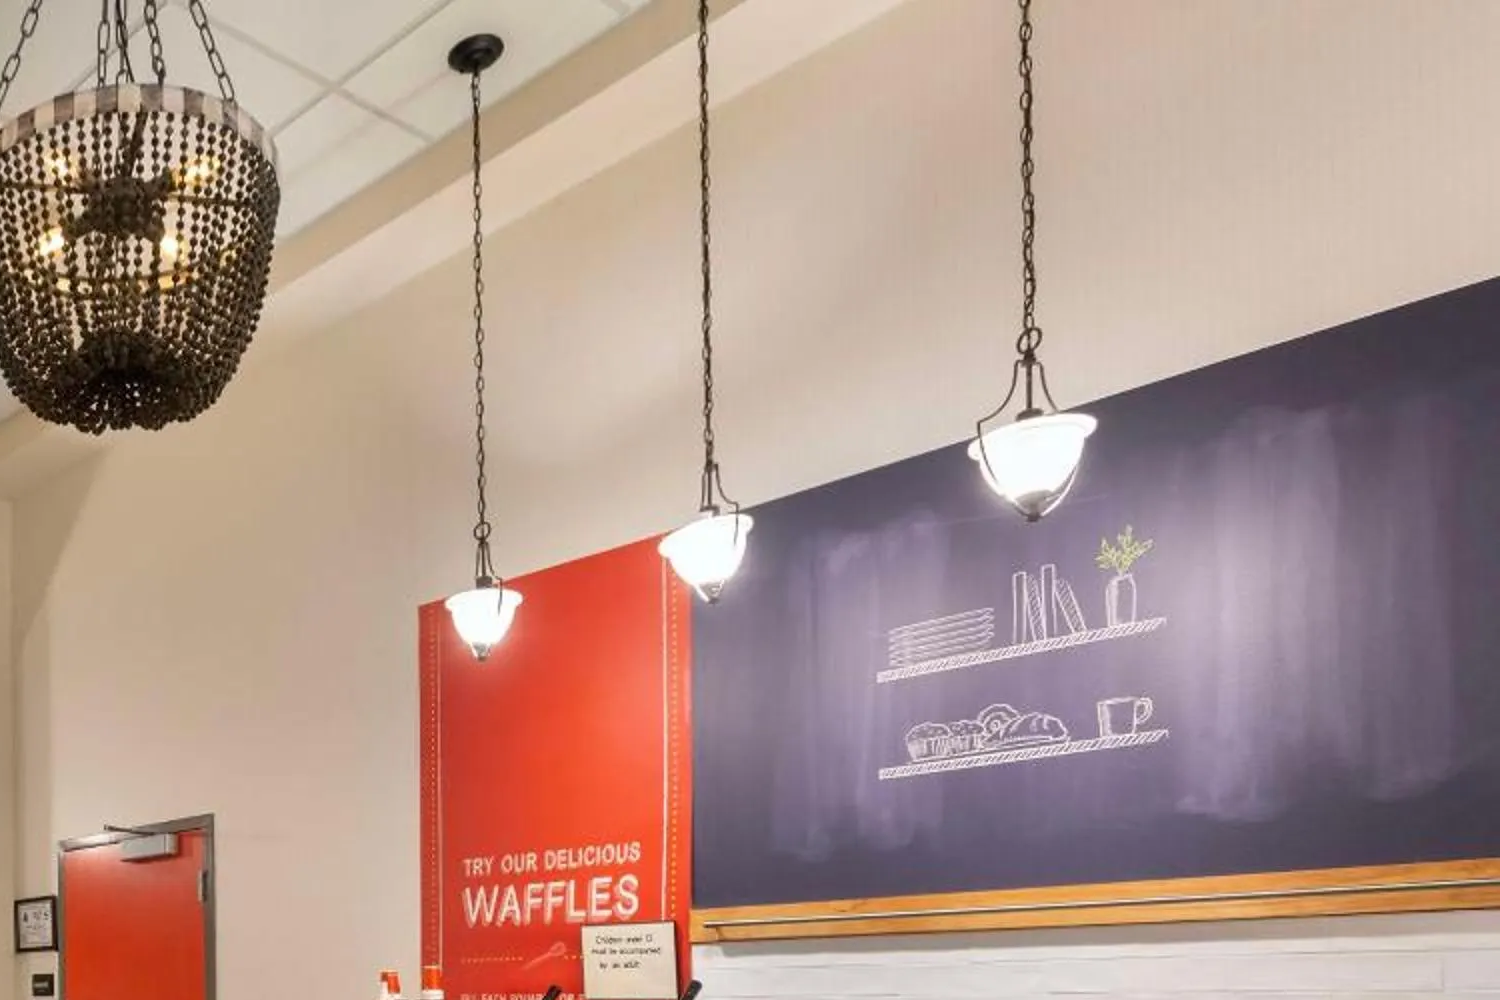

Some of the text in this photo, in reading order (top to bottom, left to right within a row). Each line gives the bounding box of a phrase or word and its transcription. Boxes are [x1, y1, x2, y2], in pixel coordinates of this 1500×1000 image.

[463, 840, 641, 878] TRY OUR DELICIOUS
[462, 873, 640, 929] WAFFLES
